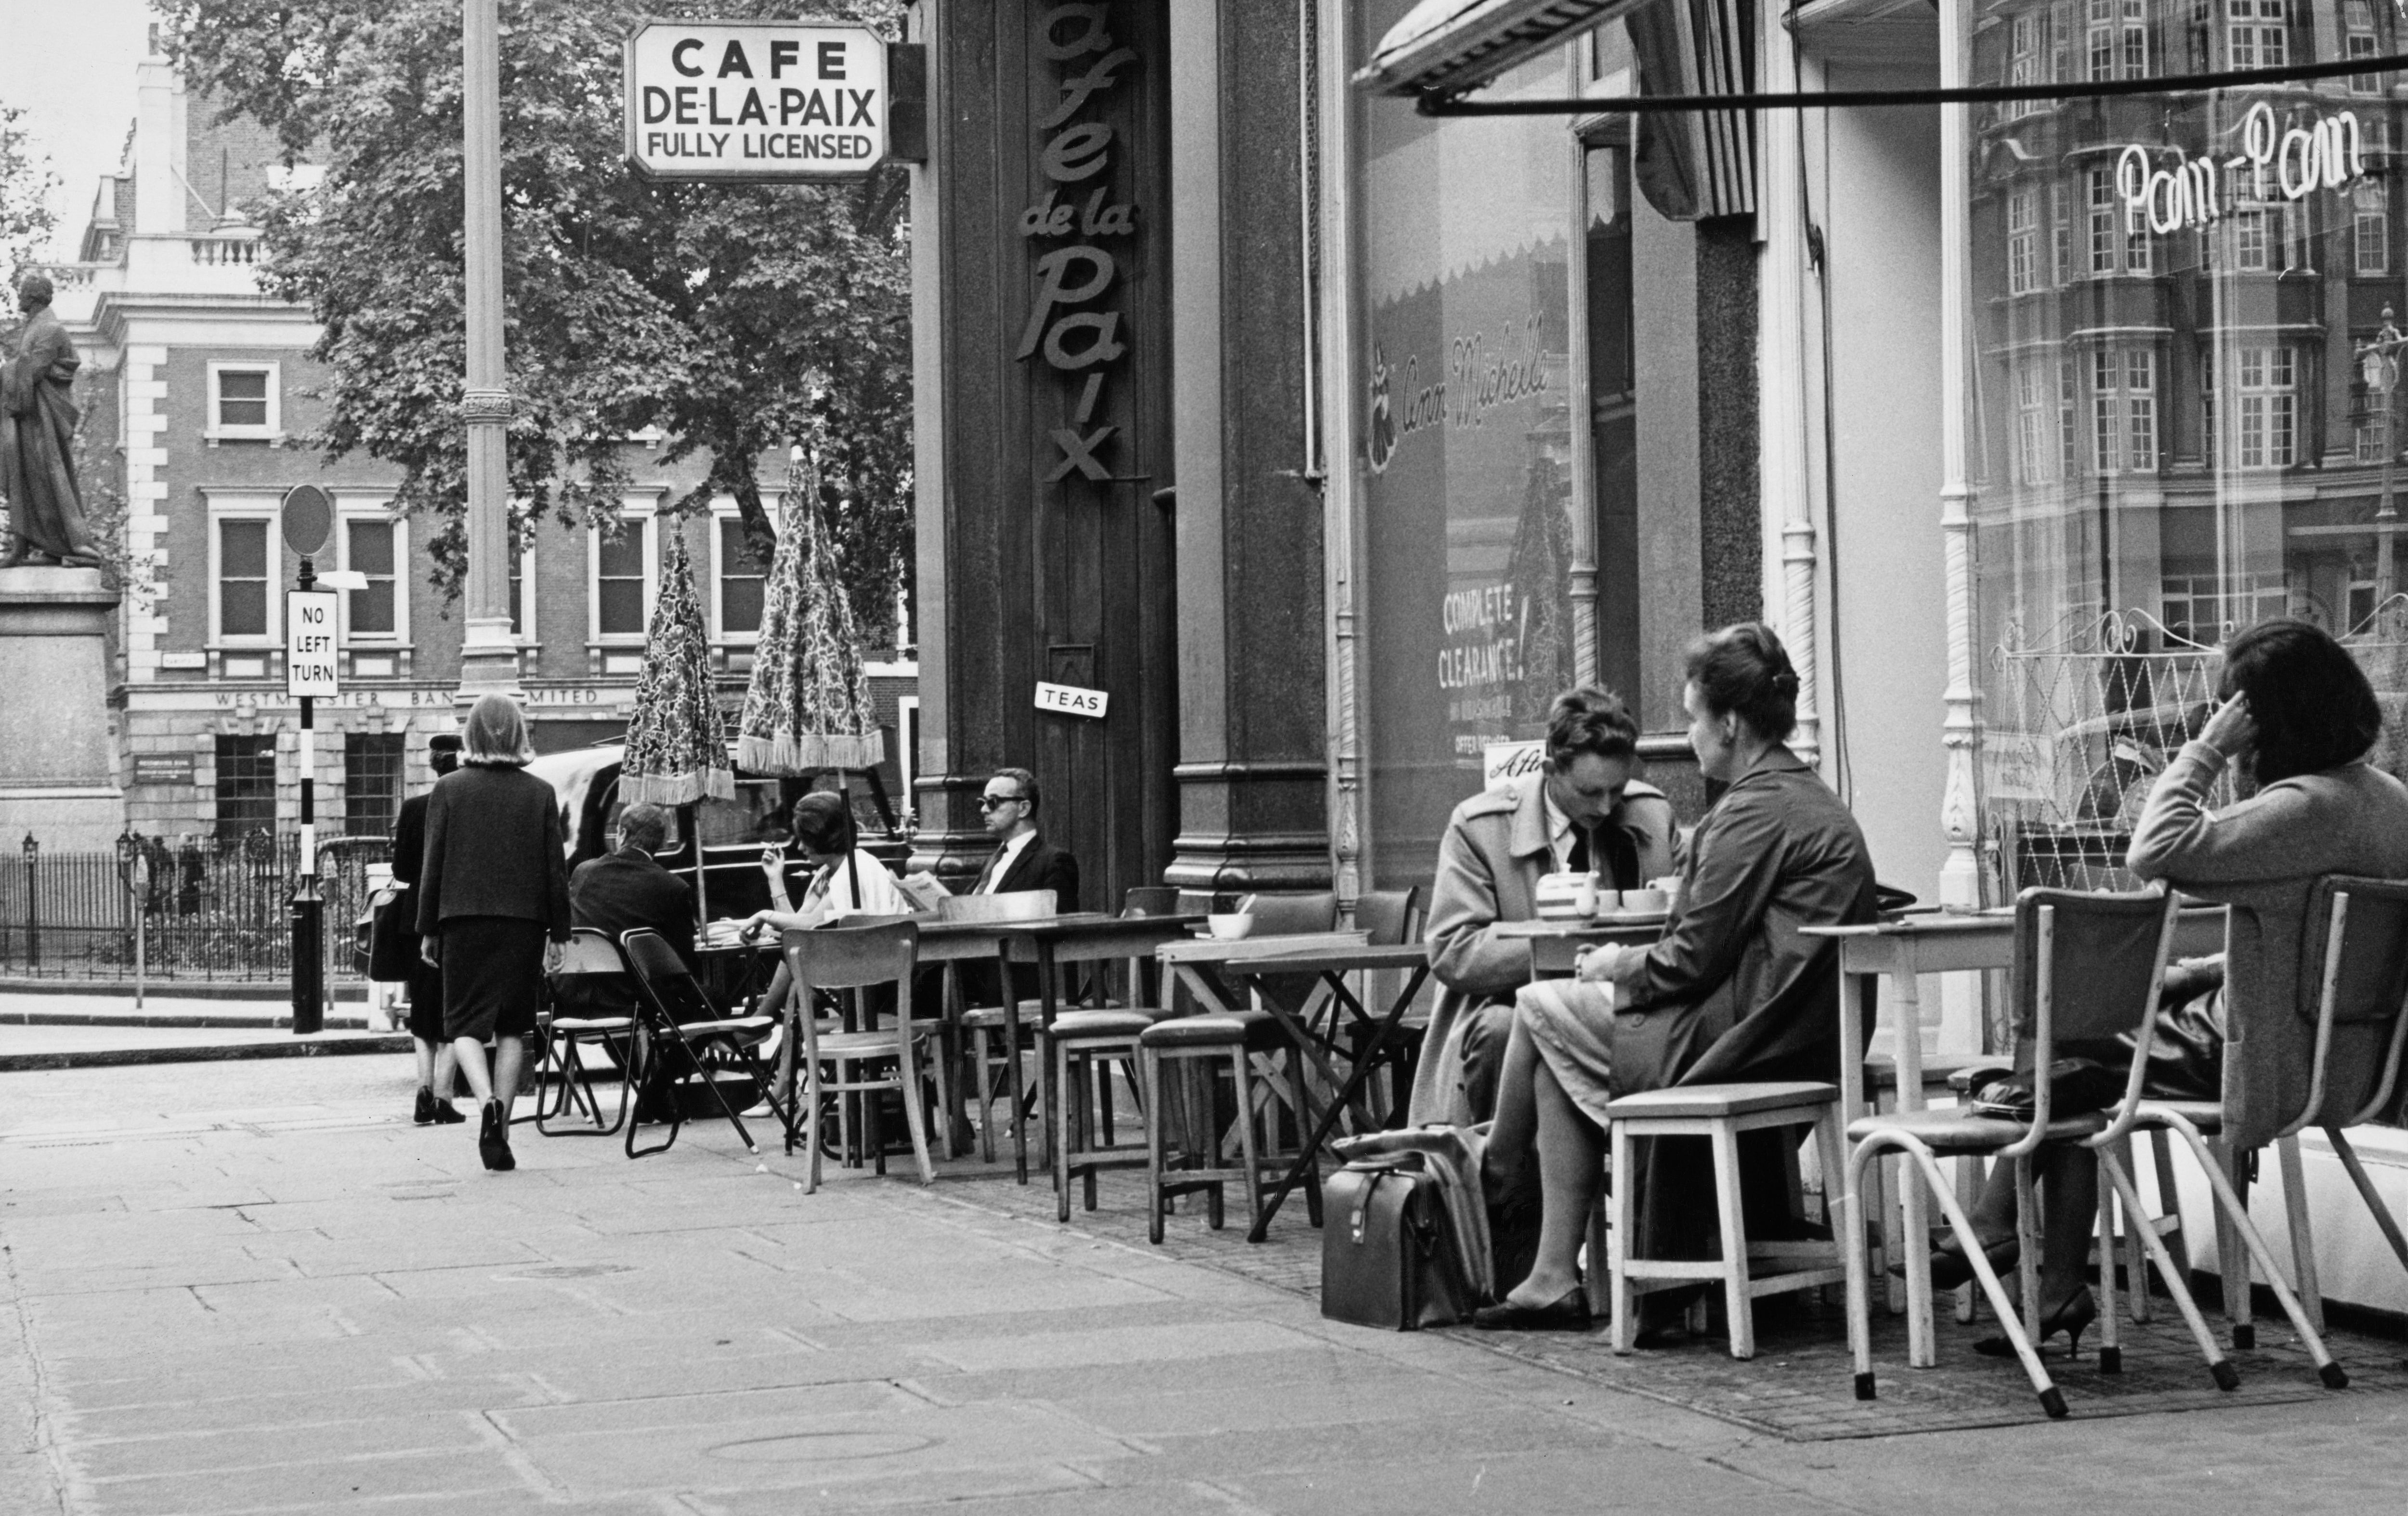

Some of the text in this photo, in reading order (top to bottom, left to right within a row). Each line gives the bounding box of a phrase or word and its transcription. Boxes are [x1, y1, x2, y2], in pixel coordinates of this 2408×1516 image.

[672, 39, 846, 80] CAFE
[643, 86, 876, 127] DE-LA-PAIX
[1039, 2, 1137, 182] afe
[648, 132, 872, 159] FULLY LICENSED
[2117, 102, 2364, 235] Pam-Pam
[1018, 185, 1134, 236] de la
[1015, 245, 1126, 482] Paix
[1403, 311, 1548, 433] Ann Michelle
[303, 607, 324, 624] NO
[1444, 584, 1512, 635] COMPLETE
[297, 636, 330, 653] LEFT
[292, 665, 333, 681] TURN
[217, 690, 597, 707] WESTMNSTER BAN MITED
[1045, 689, 1098, 710] TEAS
